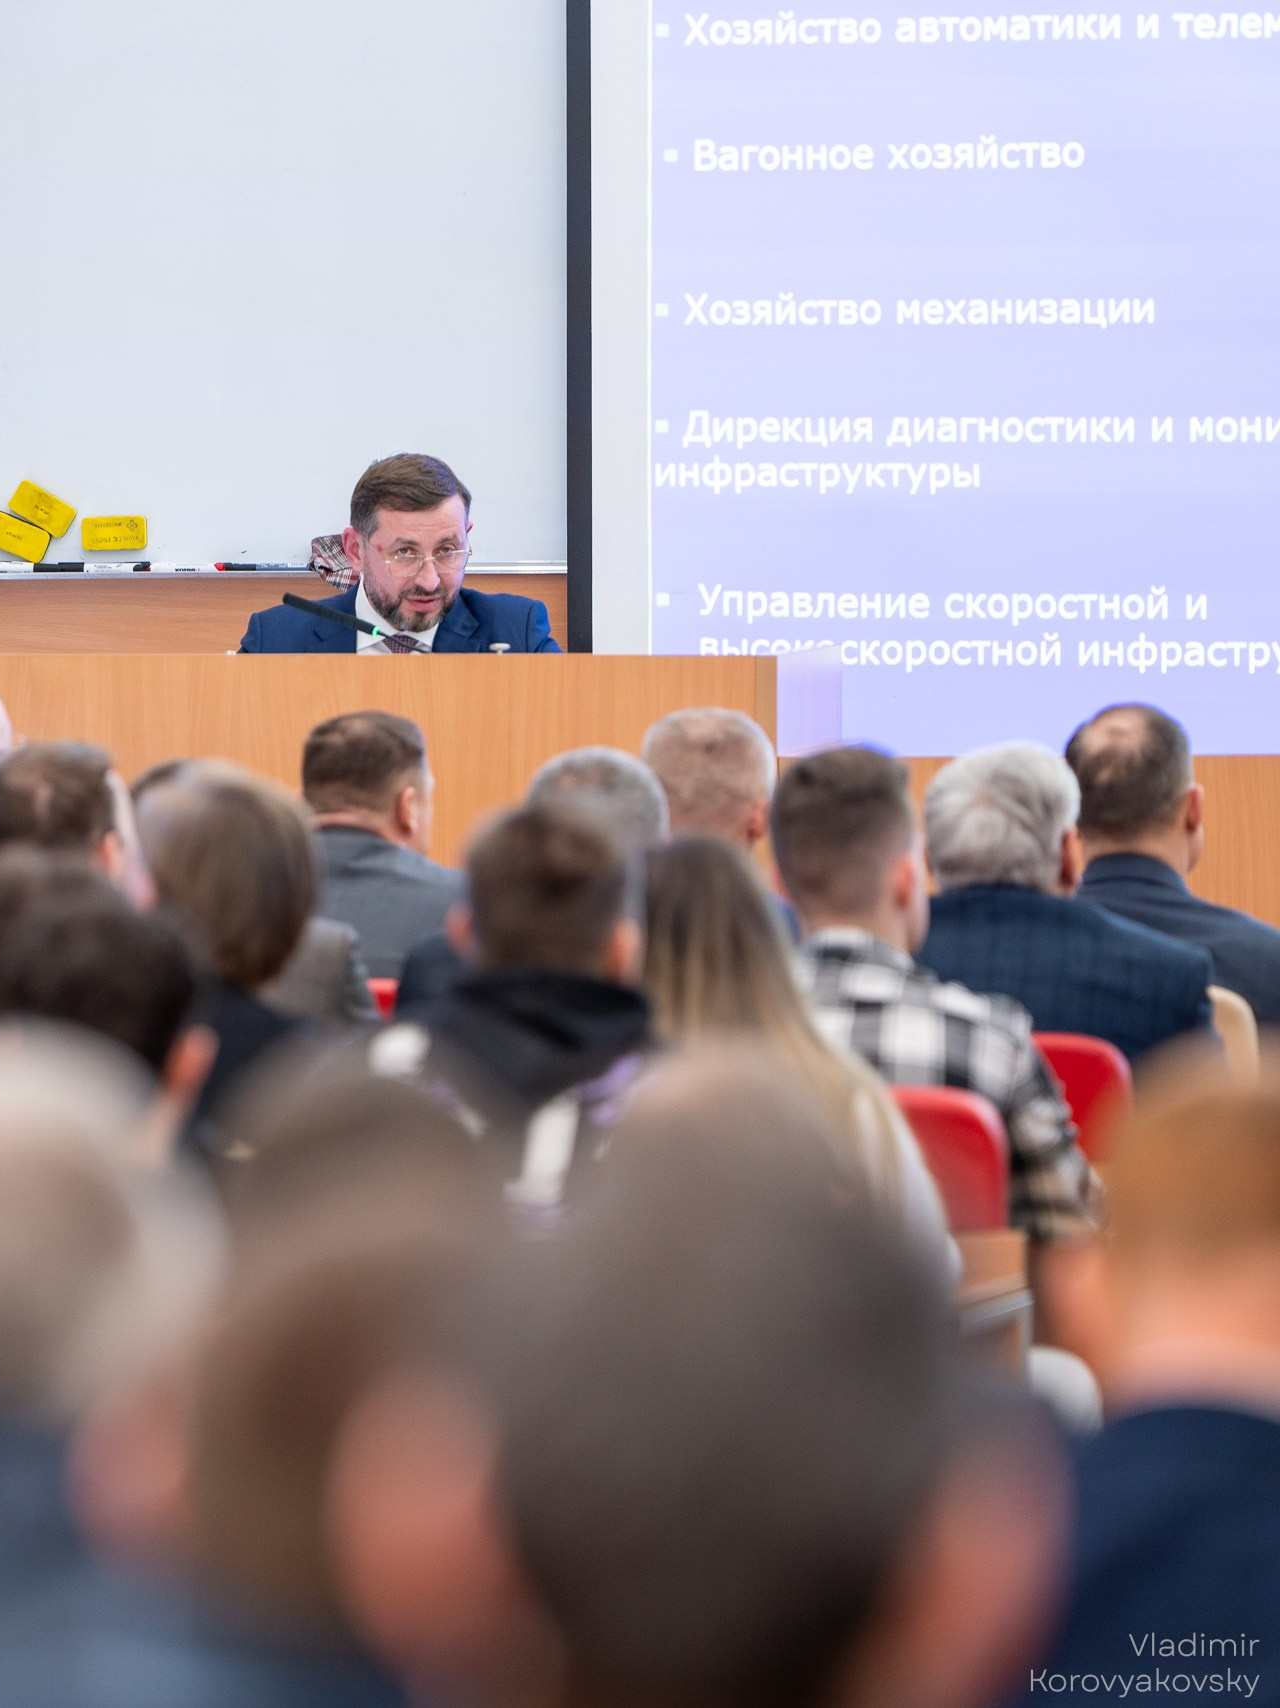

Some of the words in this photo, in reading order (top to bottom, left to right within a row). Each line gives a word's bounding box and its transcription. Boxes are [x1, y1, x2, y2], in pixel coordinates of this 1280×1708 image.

[684, 11, 882, 46] Хозяйство
[894, 13, 1122, 43] автоматики
[1136, 13, 1160, 39] и
[1171, 12, 1280, 40] телем
[693, 138, 874, 172] Вагонное
[887, 134, 1085, 170] хозяйство
[684, 291, 882, 326] Хозяйство
[896, 297, 1155, 329] механизации
[682, 410, 873, 448] Дирекция
[886, 416, 1135, 447] диагностики
[1151, 416, 1174, 443] и
[1189, 415, 1280, 443] мони
[655, 455, 981, 495] инфраструктуры
[697, 583, 931, 624] Управление
[944, 586, 1169, 626] скоростной
[1185, 593, 1208, 621] и
[700, 632, 1062, 673] высоскоростной
